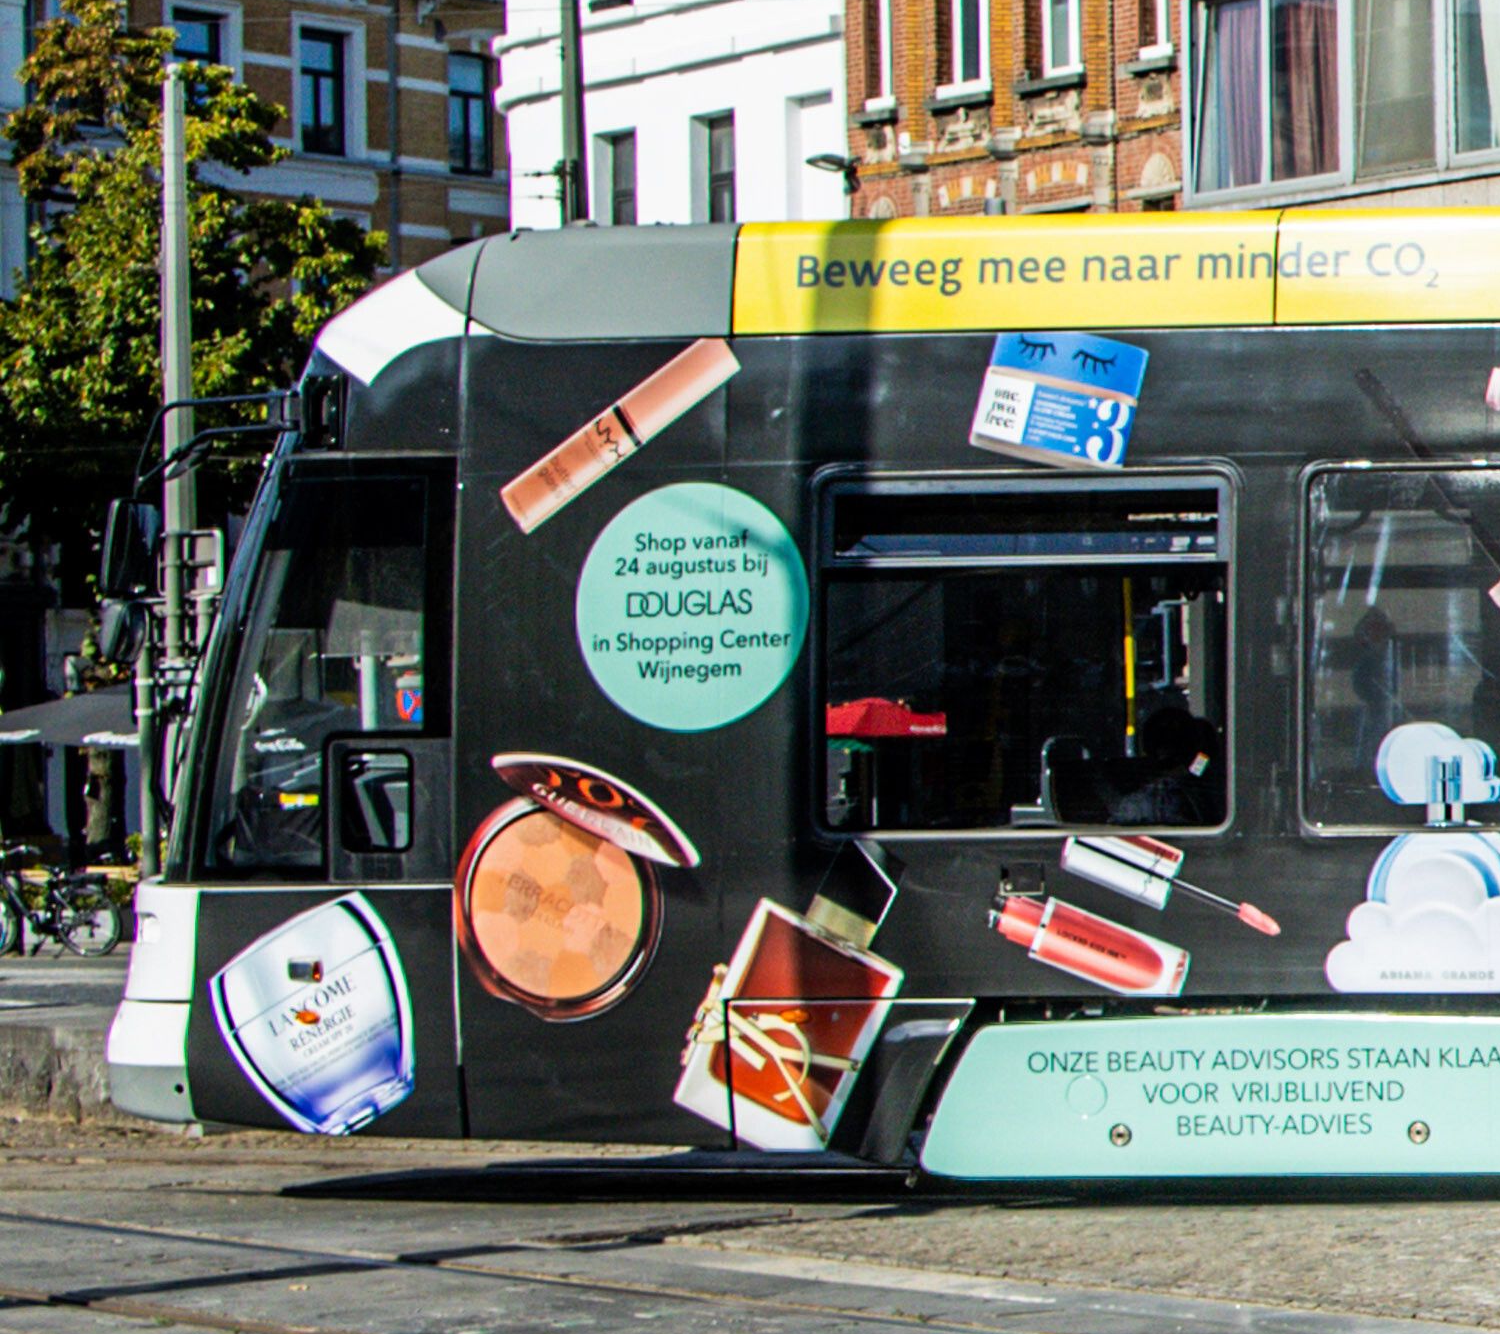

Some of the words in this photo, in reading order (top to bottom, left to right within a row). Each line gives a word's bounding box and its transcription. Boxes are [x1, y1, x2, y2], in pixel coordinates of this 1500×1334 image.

[796, 254, 963, 297] Beweeg
[978, 255, 1066, 283] mee
[1082, 253, 1182, 282] naar
[1197, 241, 1350, 280] minder
[1085, 398, 1131, 465] 3
[635, 532, 687, 556] Shop
[692, 528, 749, 550] vanaf
[614, 557, 639, 576] 24
[645, 557, 737, 580] augustus
[742, 553, 769, 577] bij
[625, 588, 753, 618] DOUGLAS
[592, 633, 611, 652] in
[616, 631, 714, 656] Shopping
[719, 629, 791, 649] Center
[637, 660, 742, 684] Wijnegem
[1027, 1050, 1098, 1073] ONZE
[1107, 1049, 1205, 1072] BEAUTY
[1211, 1048, 1340, 1071] ADVISORS
[1348, 1047, 1430, 1068] STAAN
[1142, 1082, 1219, 1104] VOOR
[1232, 1080, 1405, 1103] VRIJBLIJVEND
[1177, 1113, 1373, 1136] BEAUTY-ADVIES
